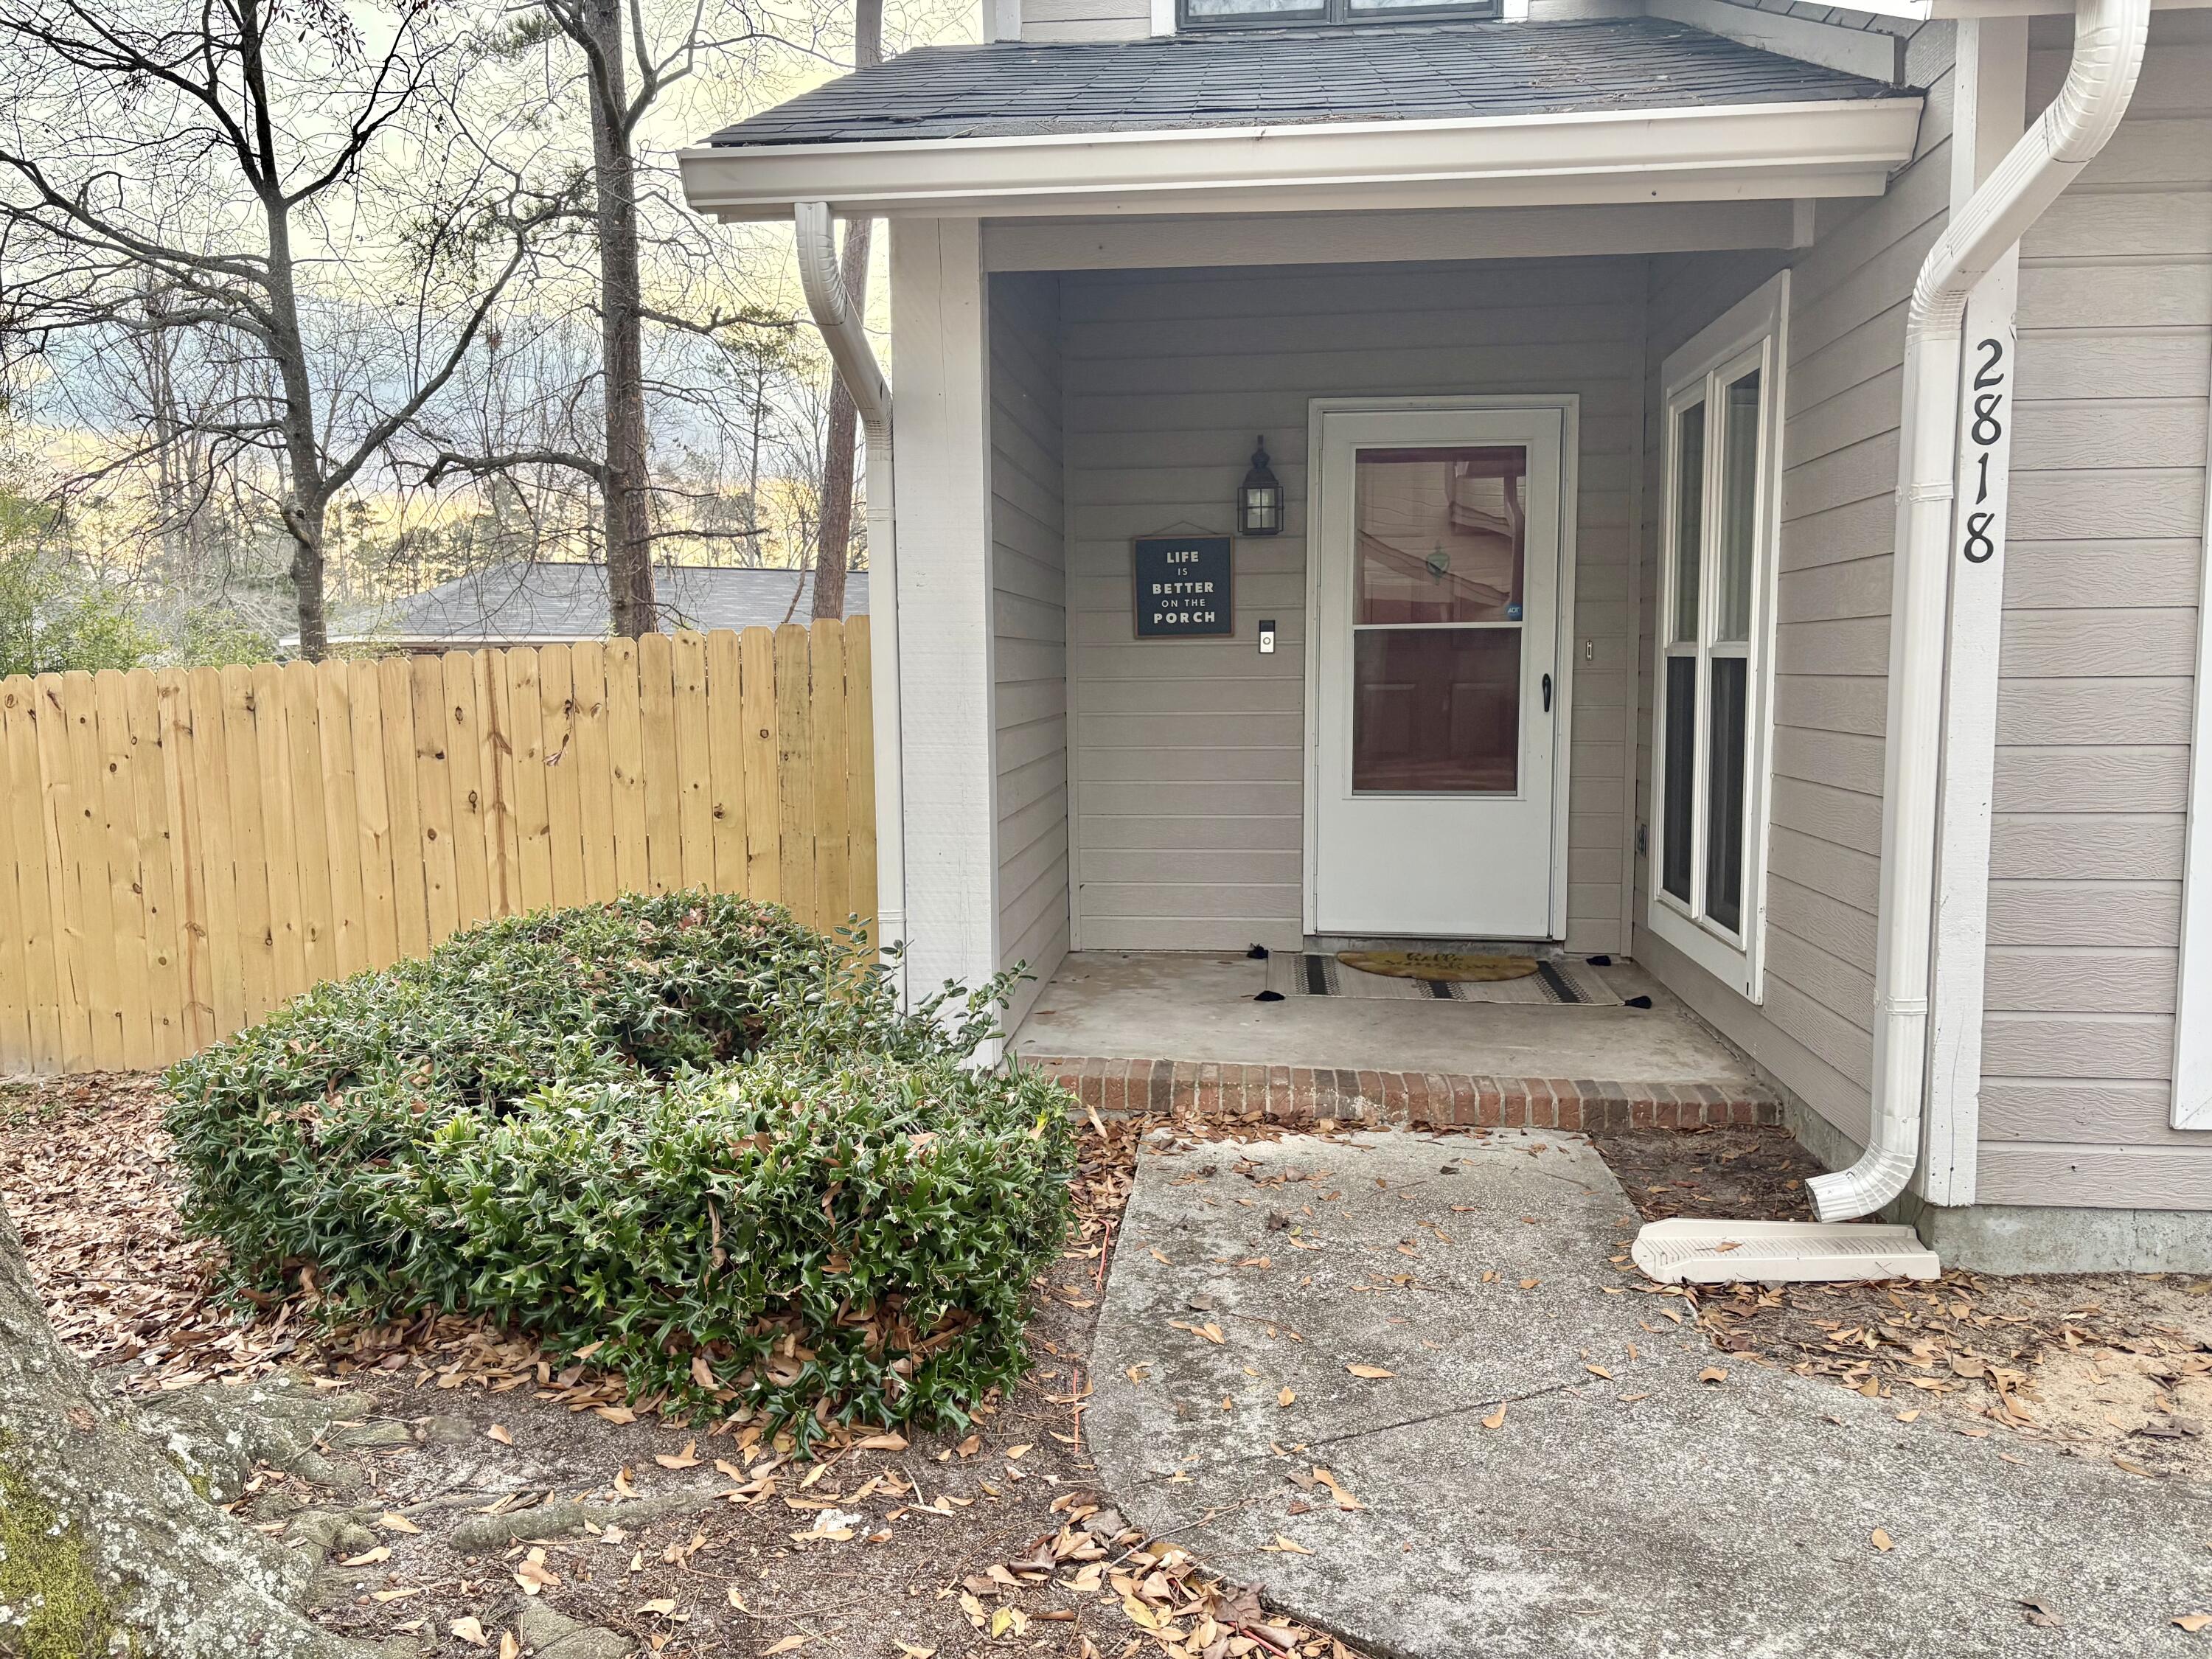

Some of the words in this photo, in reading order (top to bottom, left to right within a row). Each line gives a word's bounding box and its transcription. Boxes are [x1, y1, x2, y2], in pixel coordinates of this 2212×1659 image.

[1964, 338, 2004, 563] 2818
[1166, 551, 1199, 563] LIFE
[1178, 568, 1188, 576] IS
[1152, 582, 1214, 594] BETTER
[1161, 599, 1178, 608] ON
[1184, 599, 1206, 607] THE
[1153, 611, 1215, 624] PORCH
